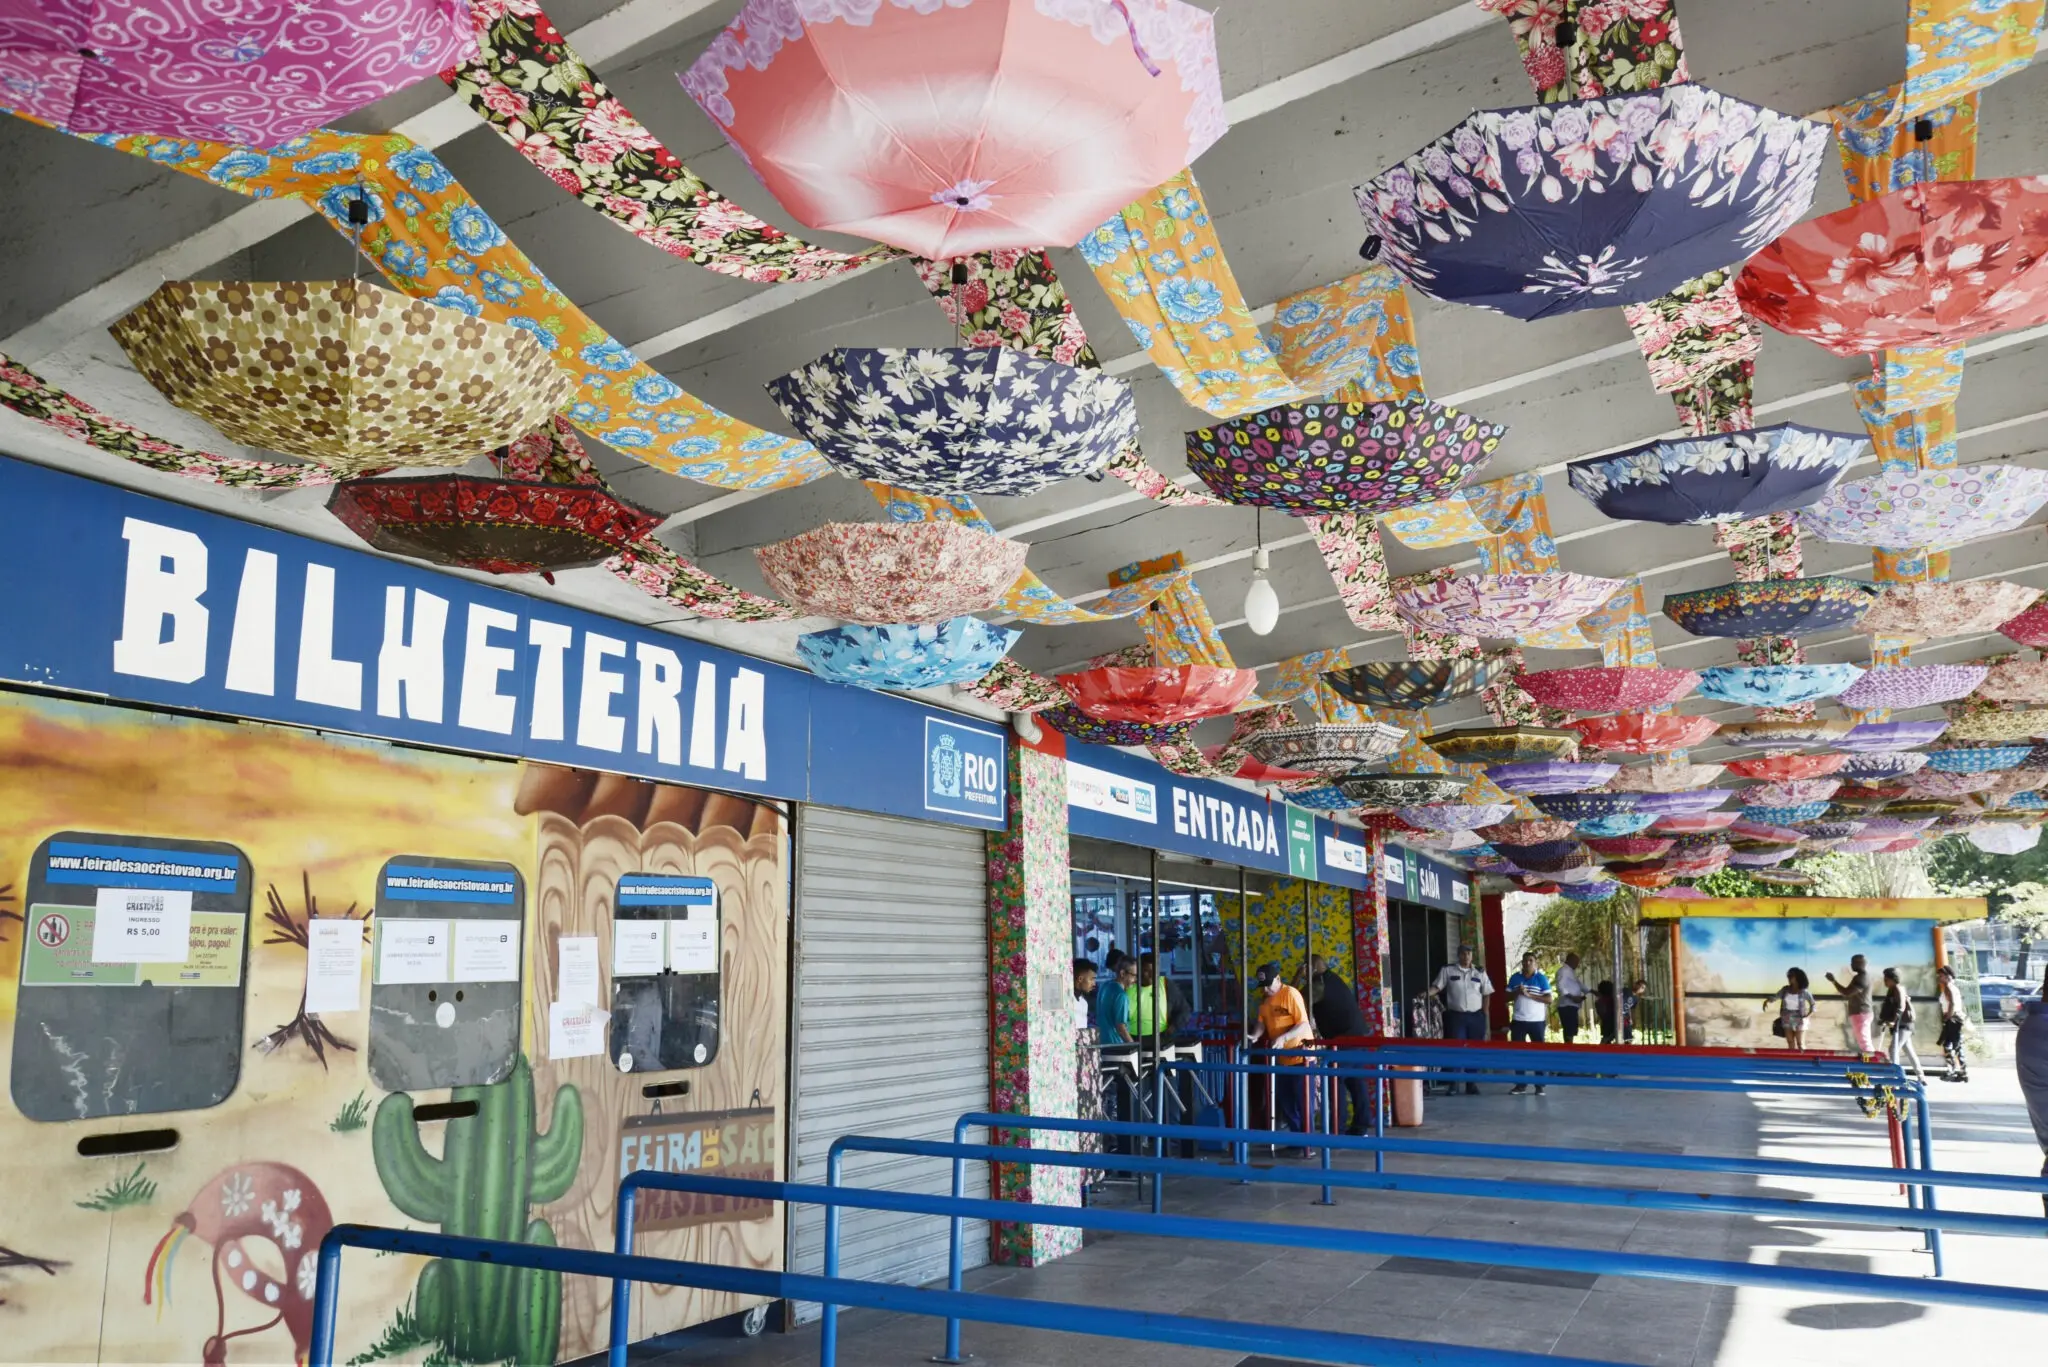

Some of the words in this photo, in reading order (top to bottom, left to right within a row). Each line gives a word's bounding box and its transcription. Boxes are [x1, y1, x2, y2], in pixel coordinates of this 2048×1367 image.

[113, 516, 767, 781] BILHETERIA
[964, 752, 998, 792] RIO
[964, 791, 998, 805] PREFEITURA
[1173, 786, 1280, 857] ENTRADA
[49, 856, 236, 880] www.feiradesaocristovao.org.br
[387, 876, 514, 893] www.feiradesaocristovao.org.br
[1420, 862, 1440, 900] SAÍDA
[141, 928, 160, 937] 5,00
[189, 937, 206, 949] ujou,
[208, 938, 231, 950] pagou!
[207, 927, 219, 937] pra
[702, 1127, 720, 1169] DE
